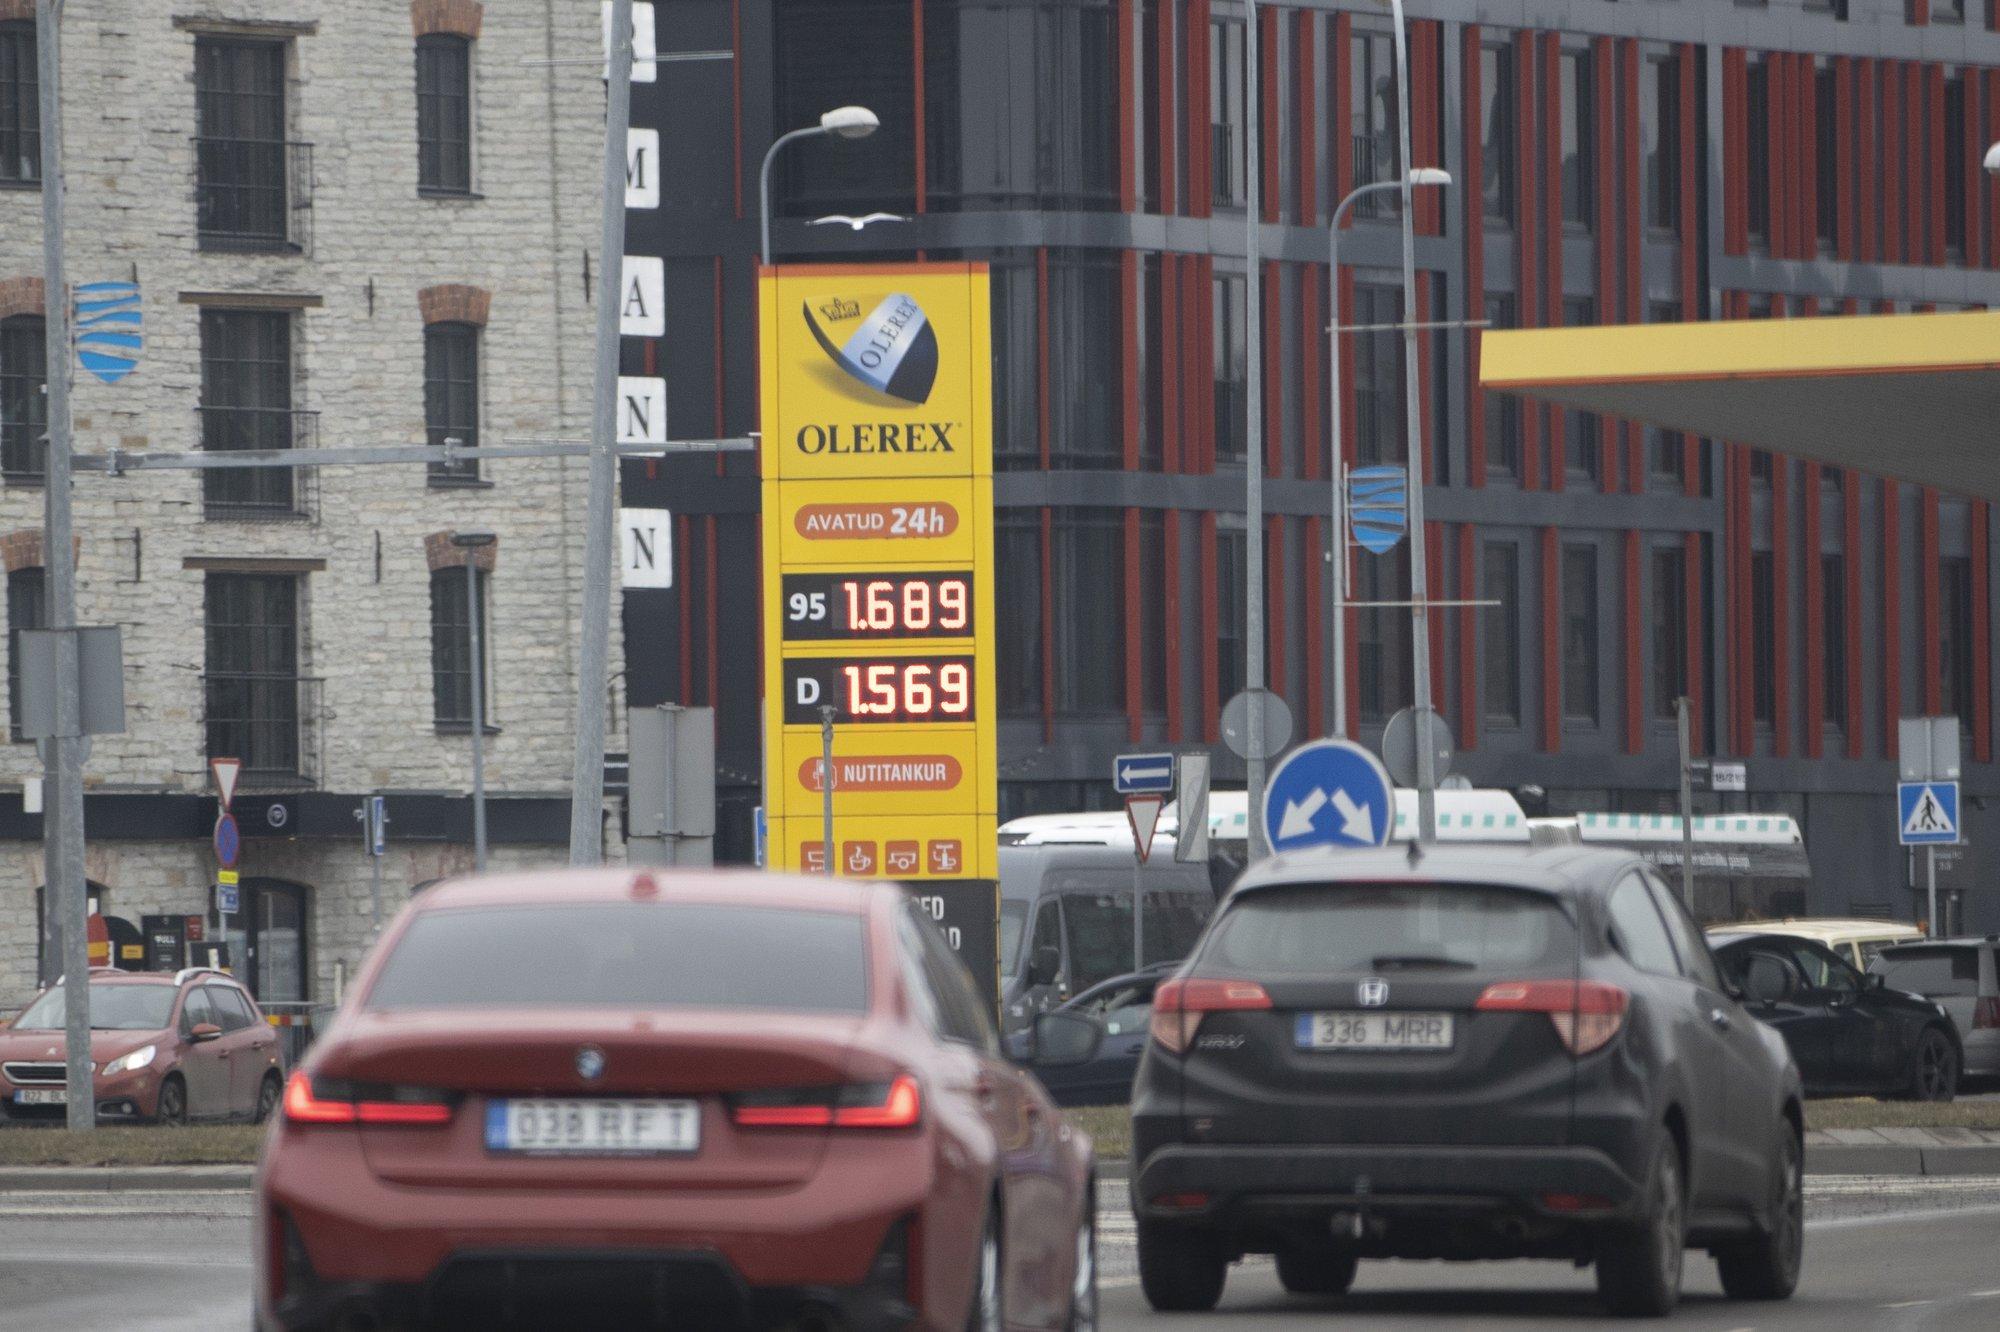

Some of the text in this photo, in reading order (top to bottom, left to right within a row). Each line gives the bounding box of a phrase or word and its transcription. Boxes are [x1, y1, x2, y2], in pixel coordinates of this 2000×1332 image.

[860, 296, 920, 369] OLEREX
[796, 421, 954, 454] OLEREX
[806, 507, 944, 534] AVATUD 24h
[788, 580, 967, 630] 95 1.689
[796, 663, 969, 714] D 1.569
[843, 763, 947, 783] NUTITANKUR
[1321, 1018, 1445, 1044] 336 MRR
